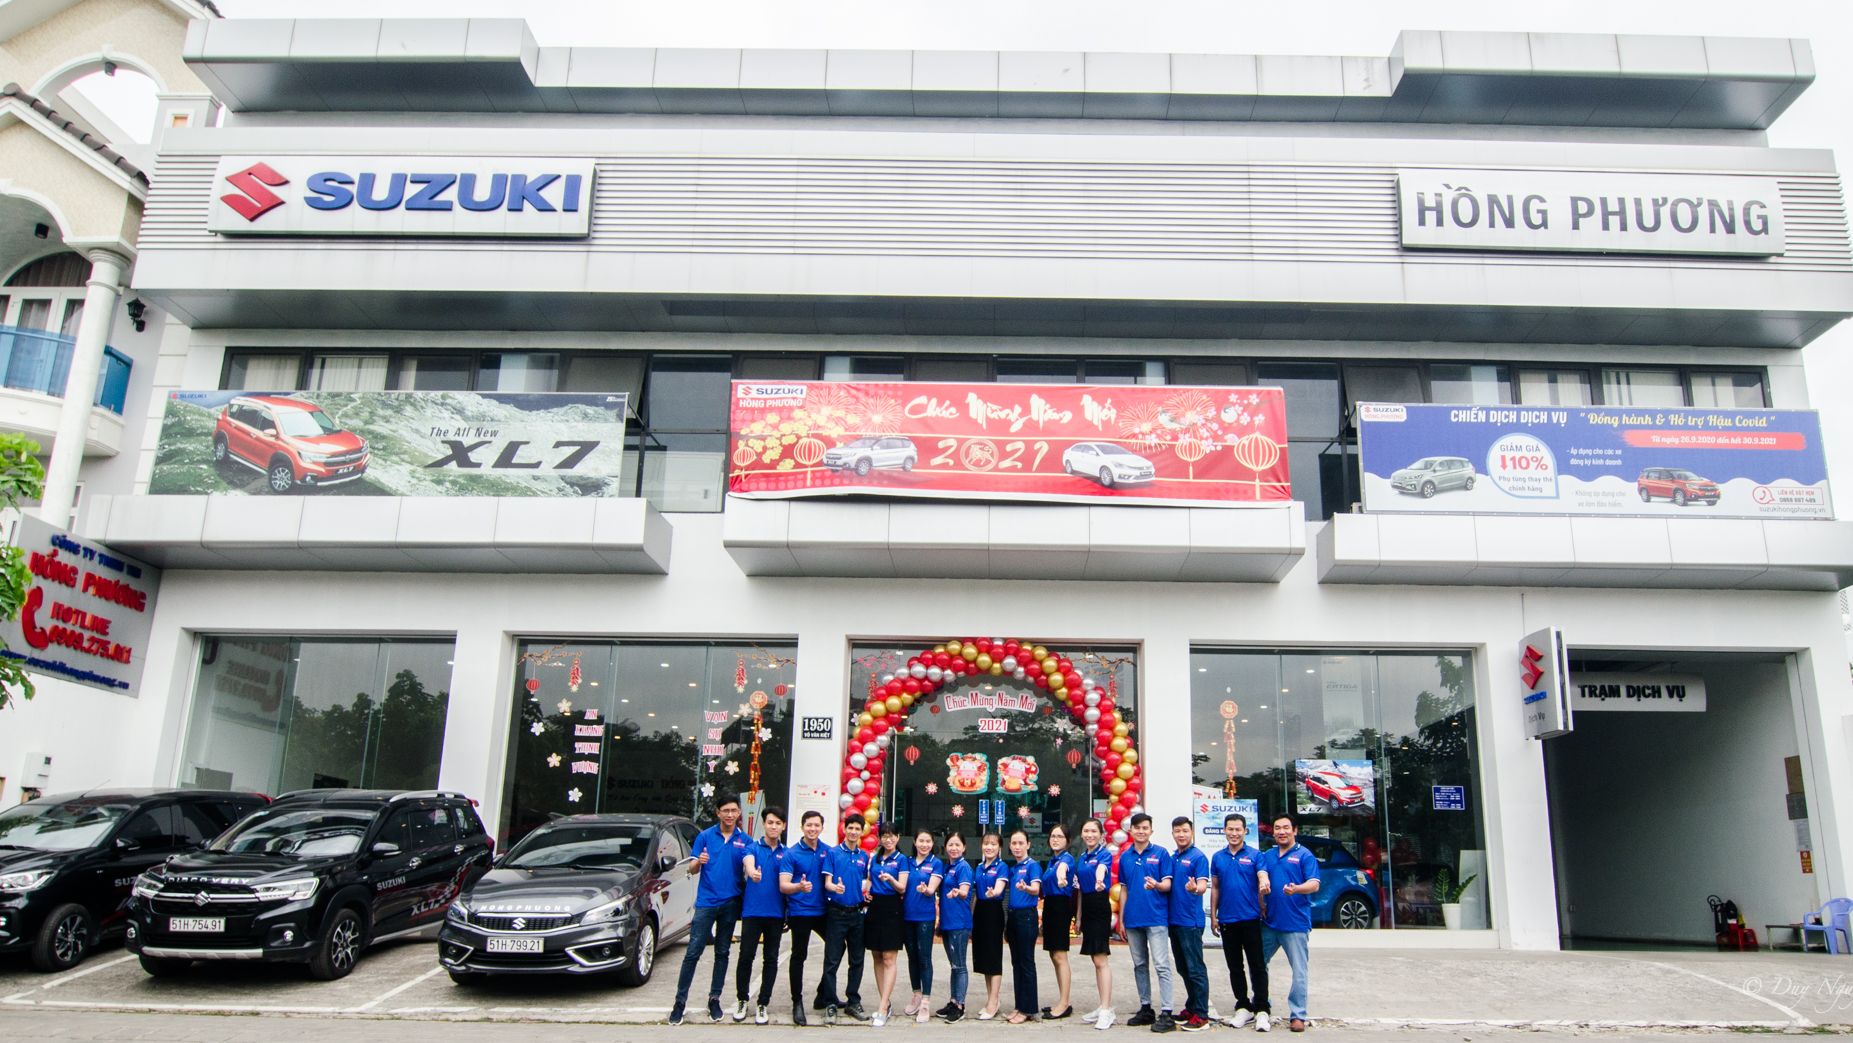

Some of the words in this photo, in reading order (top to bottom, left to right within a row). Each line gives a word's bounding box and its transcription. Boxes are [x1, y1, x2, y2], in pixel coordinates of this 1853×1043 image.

[304, 171, 582, 212] SUZUKI
[1416, 182, 1550, 231] HỒNG
[1570, 195, 1770, 236] PHƯƠNG
[756, 387, 803, 395] SUZUKI
[904, 395, 960, 419] Chúc
[966, 392, 1029, 433] Mừng
[1080, 394, 1117, 431] Mới
[1450, 406, 1486, 422] CHIẾN
[1489, 410, 1516, 426] DỊCH
[1520, 411, 1547, 426] DỊCH
[1552, 411, 1567, 427] VỤ
[1622, 413, 1652, 425] hành
[1656, 414, 1665, 424] &
[430, 427, 449, 437] The
[454, 427, 470, 437] All
[474, 428, 499, 438] New
[424, 440, 600, 469] XL7
[1500, 442, 1523, 452] GIẢM
[1509, 456, 1548, 470] 10%
[29, 548, 79, 588] HỒNG
[82, 572, 147, 612] PHƯƠNG
[50, 601, 112, 636] HOTLINE
[945, 695, 967, 710] Chúc
[970, 692, 994, 710] Mừng
[997, 692, 1016, 707] Năm
[1019, 694, 1036, 711] Mới
[1578, 684, 1621, 701] TRẠM
[1626, 685, 1662, 702] DỊCH
[1665, 685, 1686, 702] VỤ
[803, 718, 831, 731] 1950
[979, 719, 1007, 731] 2021
[376, 876, 406, 891] SUZUKI
[411, 899, 436, 916] XL7
